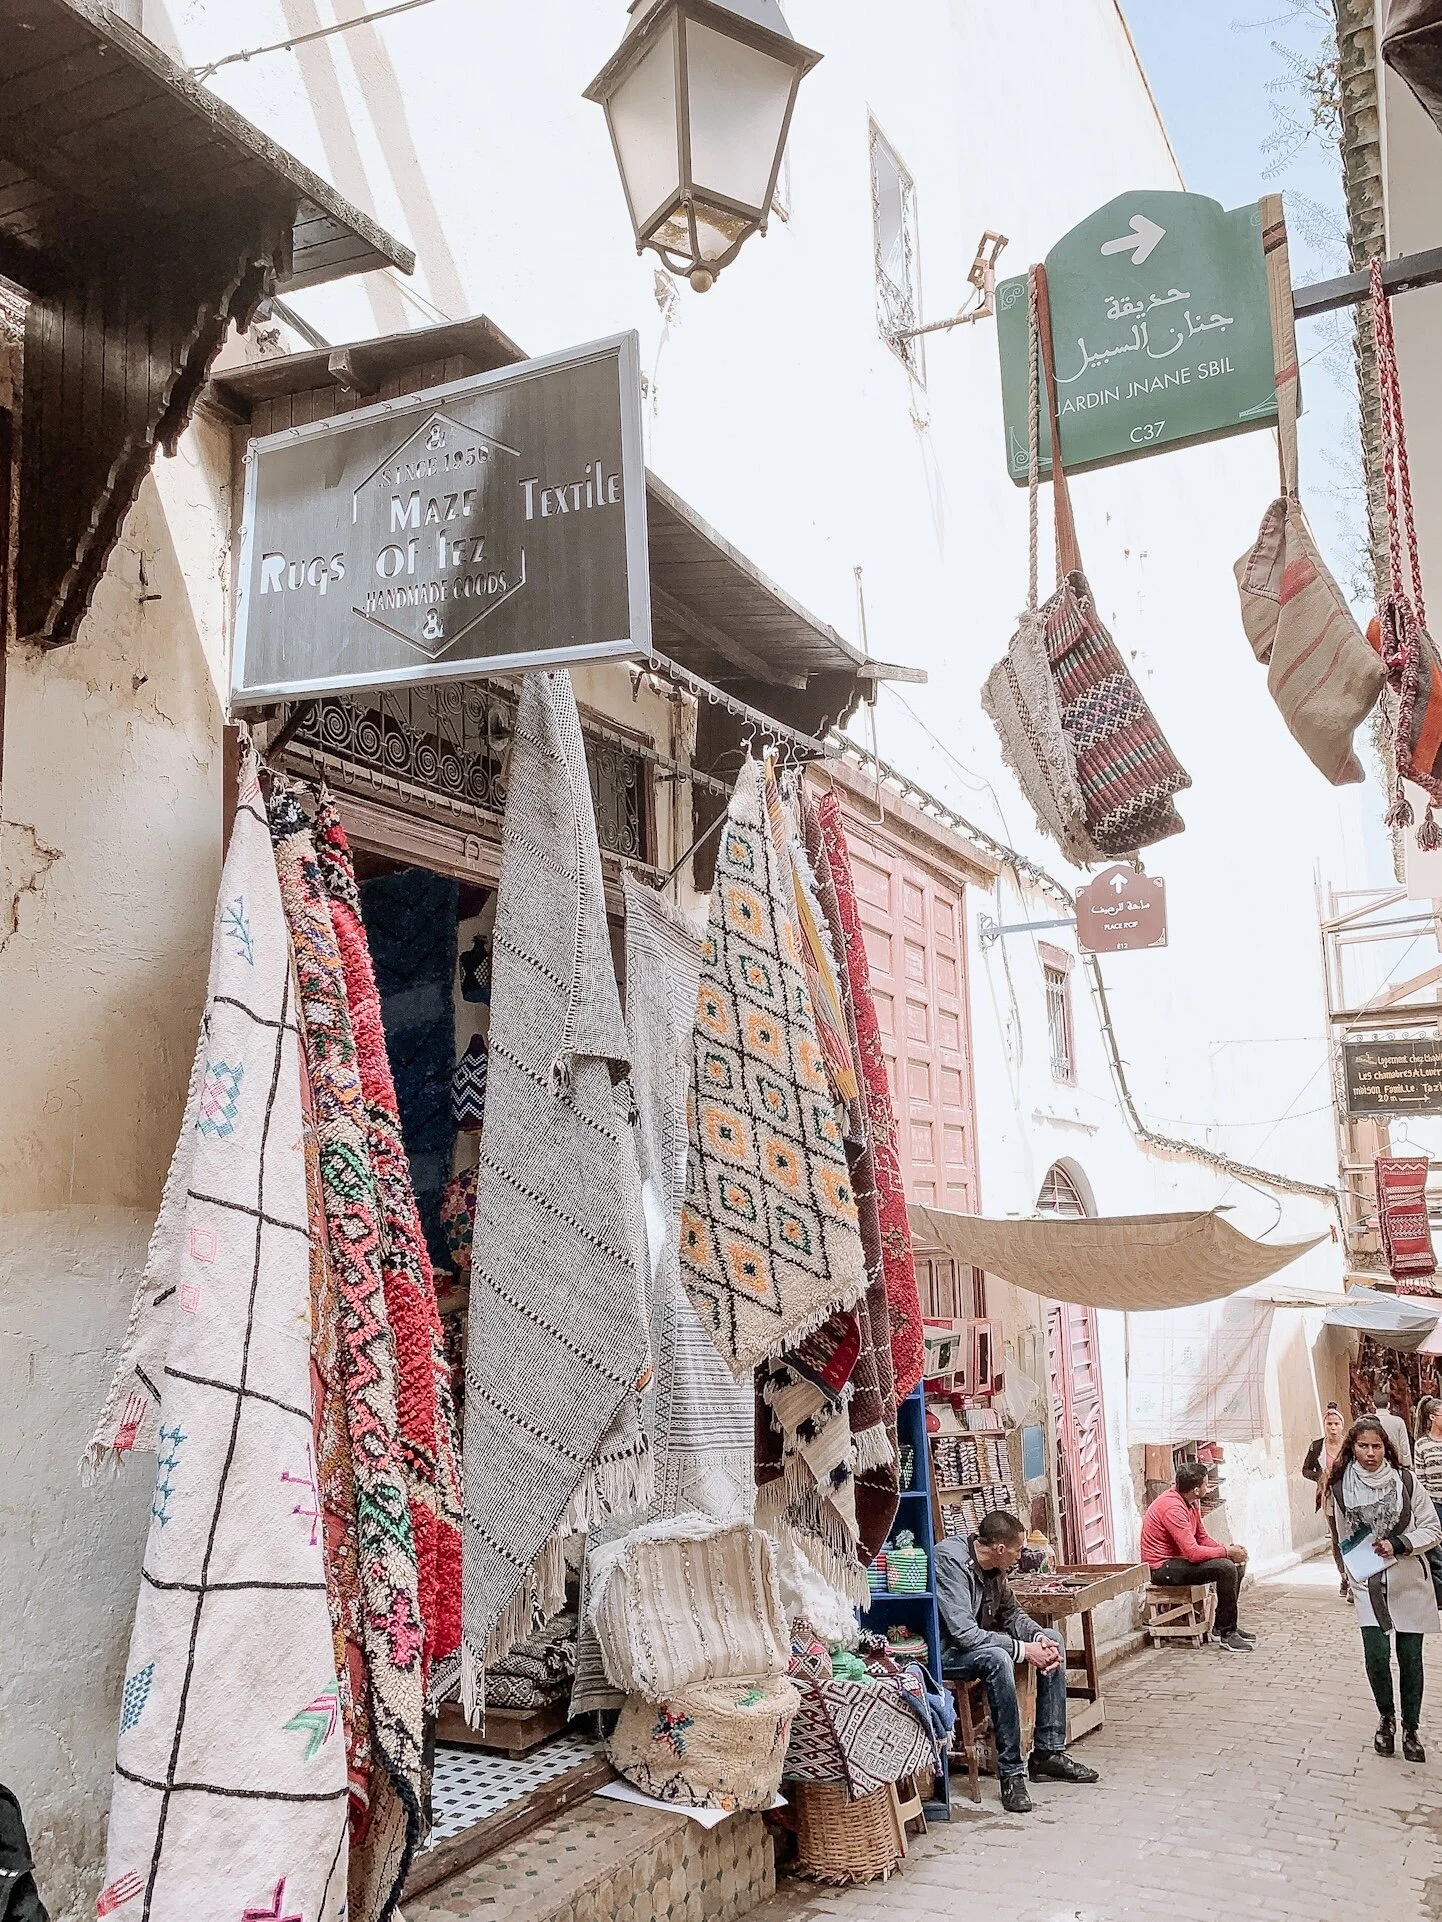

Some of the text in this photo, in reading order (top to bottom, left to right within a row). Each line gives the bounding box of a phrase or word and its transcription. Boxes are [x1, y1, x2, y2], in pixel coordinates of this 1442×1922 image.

[1104, 288, 1191, 321] حديقة
[1052, 310, 1234, 383] جنان السبيل
[1055, 356, 1235, 418] JARDIN JNANE SBIL
[1129, 420, 1166, 443] C37
[366, 579, 448, 613] HANDMADE
[1103, 922, 1123, 931] PLACE
